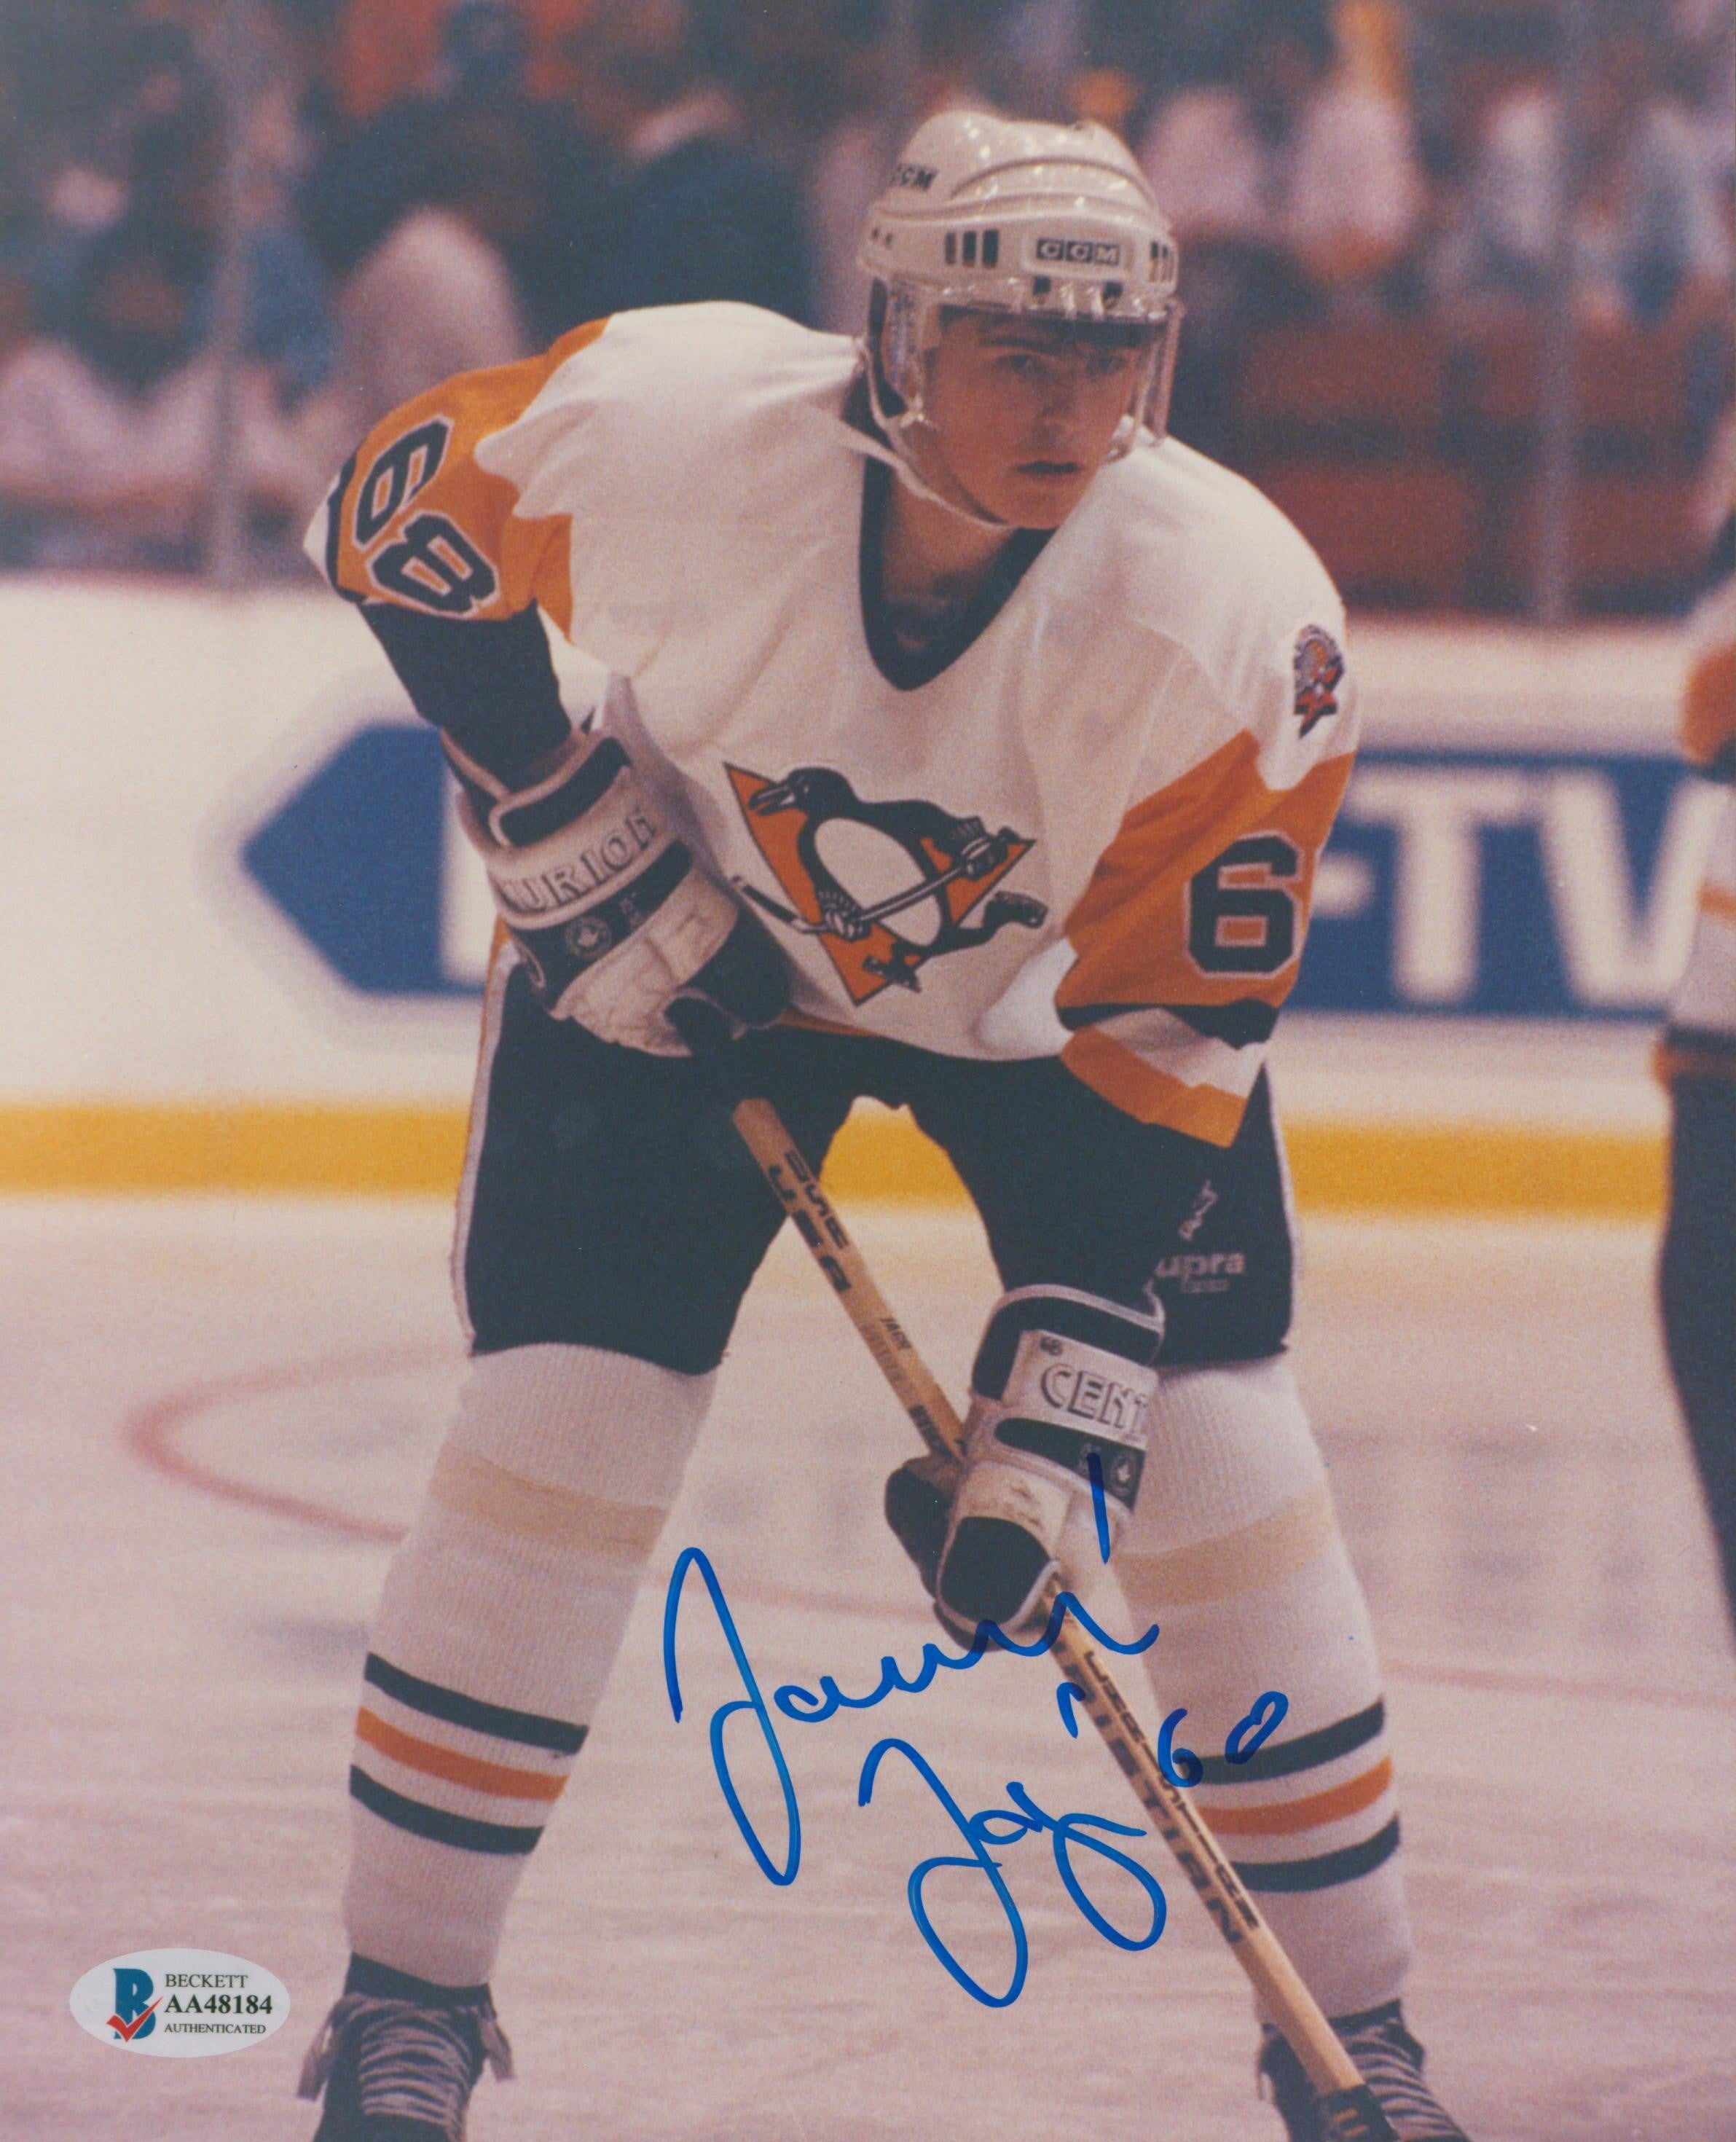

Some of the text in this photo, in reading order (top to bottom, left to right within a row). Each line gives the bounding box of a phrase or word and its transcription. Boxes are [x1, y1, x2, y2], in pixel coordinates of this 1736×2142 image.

[1037, 238, 1120, 267] CCM
[1184, 828, 1304, 981] 6
[1154, 1252, 1245, 1285] upra
[164, 1974, 248, 1988] BECKETT
[163, 1994, 273, 2014] AA48184
[163, 2023, 267, 2034] AUTHENTICATED
